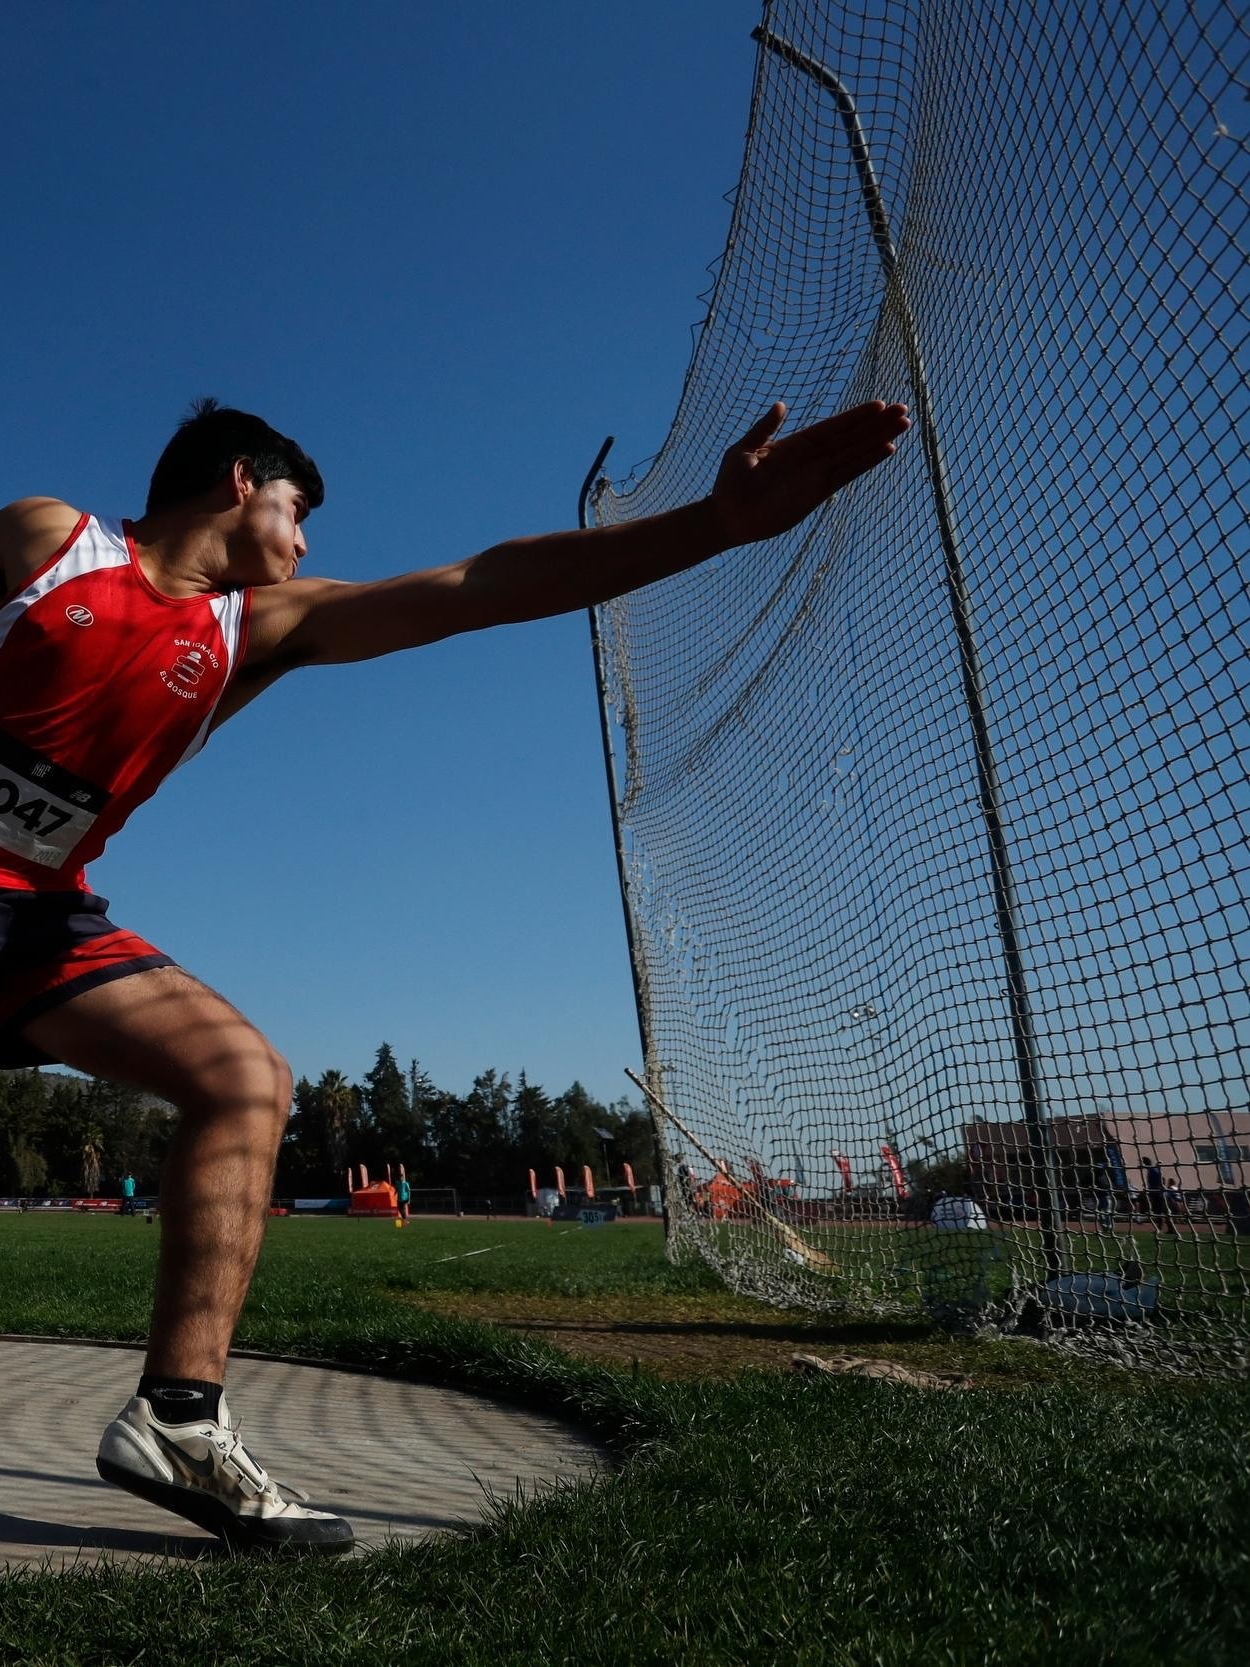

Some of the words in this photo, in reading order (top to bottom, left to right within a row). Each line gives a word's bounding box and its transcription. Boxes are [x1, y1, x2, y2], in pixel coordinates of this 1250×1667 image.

[174, 639, 191, 647] SAN
[192, 642, 219, 669] IGNACIO
[160, 670, 168, 682] EL
[167, 681, 198, 699] BOSQUE
